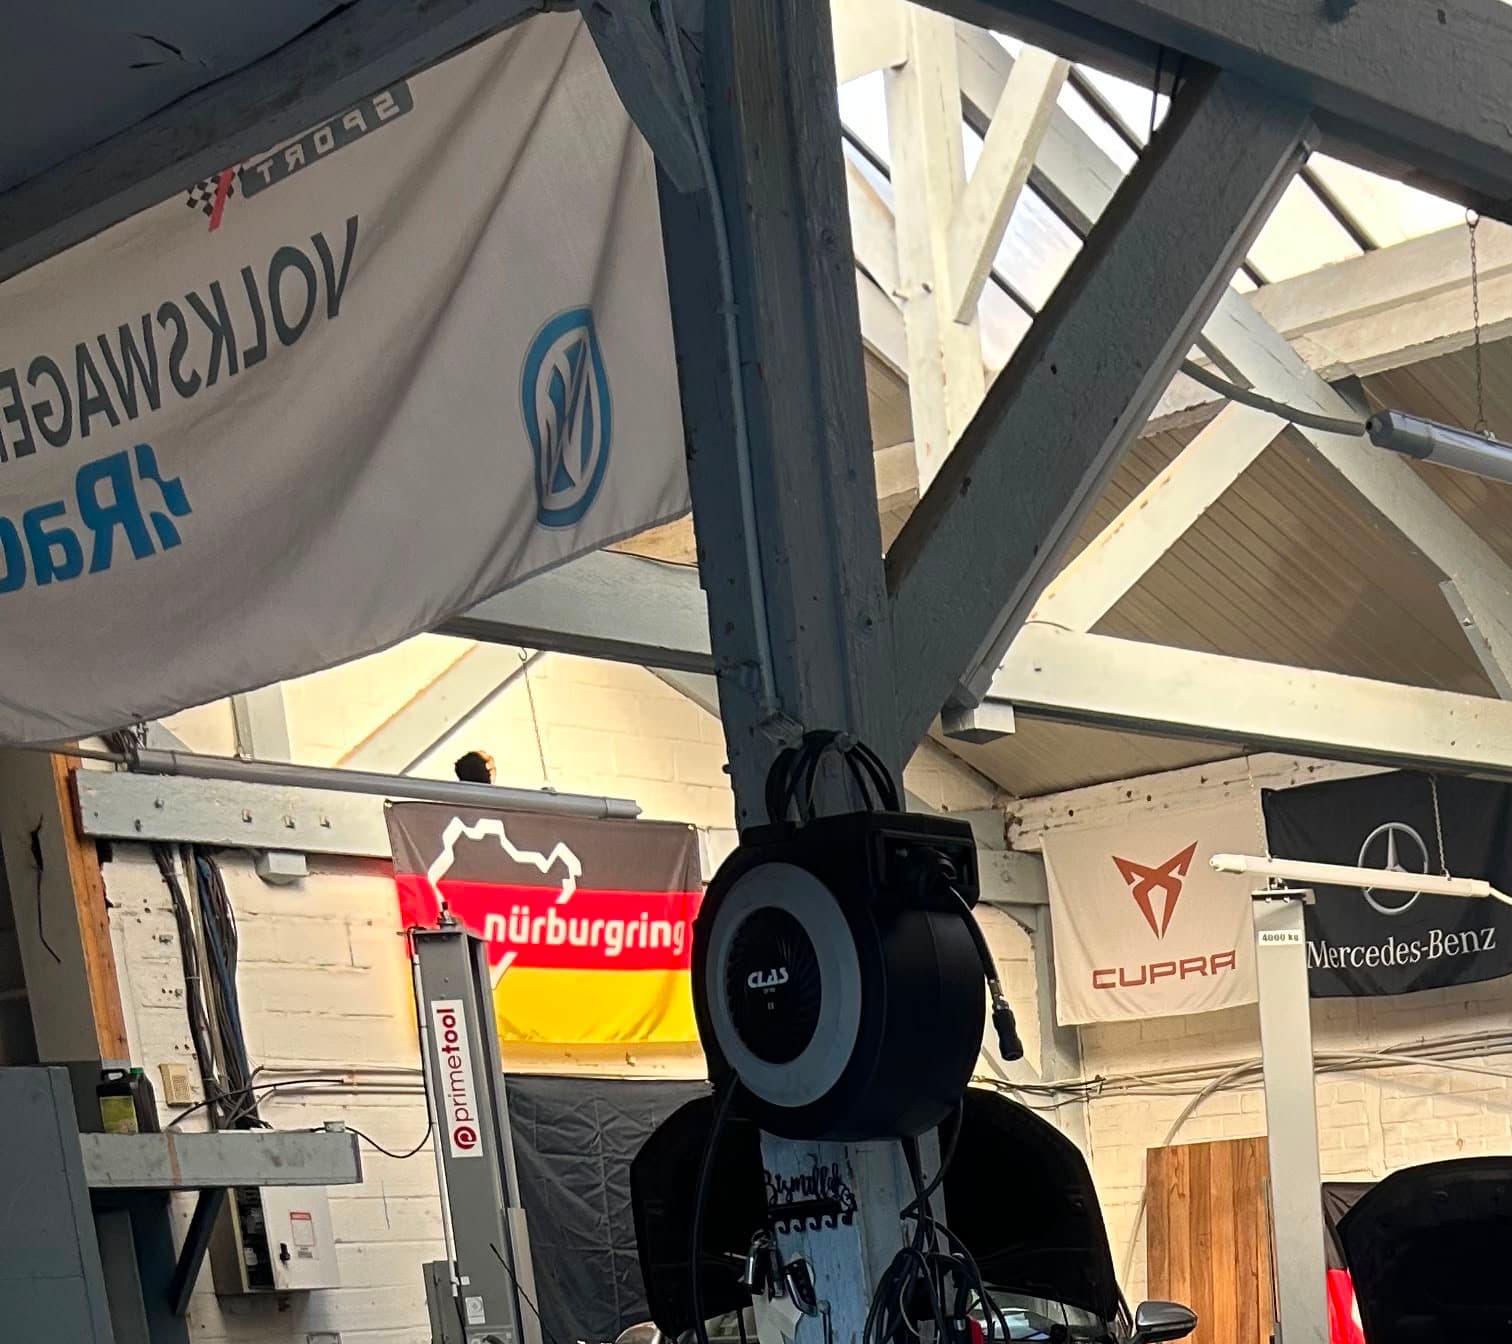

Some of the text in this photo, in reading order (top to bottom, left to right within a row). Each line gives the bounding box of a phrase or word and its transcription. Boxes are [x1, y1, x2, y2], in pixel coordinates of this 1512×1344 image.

[485, 905, 686, 957] nürburgring
[1307, 926, 1497, 969] Mercedes-Benz
[747, 967, 789, 989] CLAS
[1093, 950, 1236, 989] CUPRA
[436, 1008, 475, 1122] primetool
